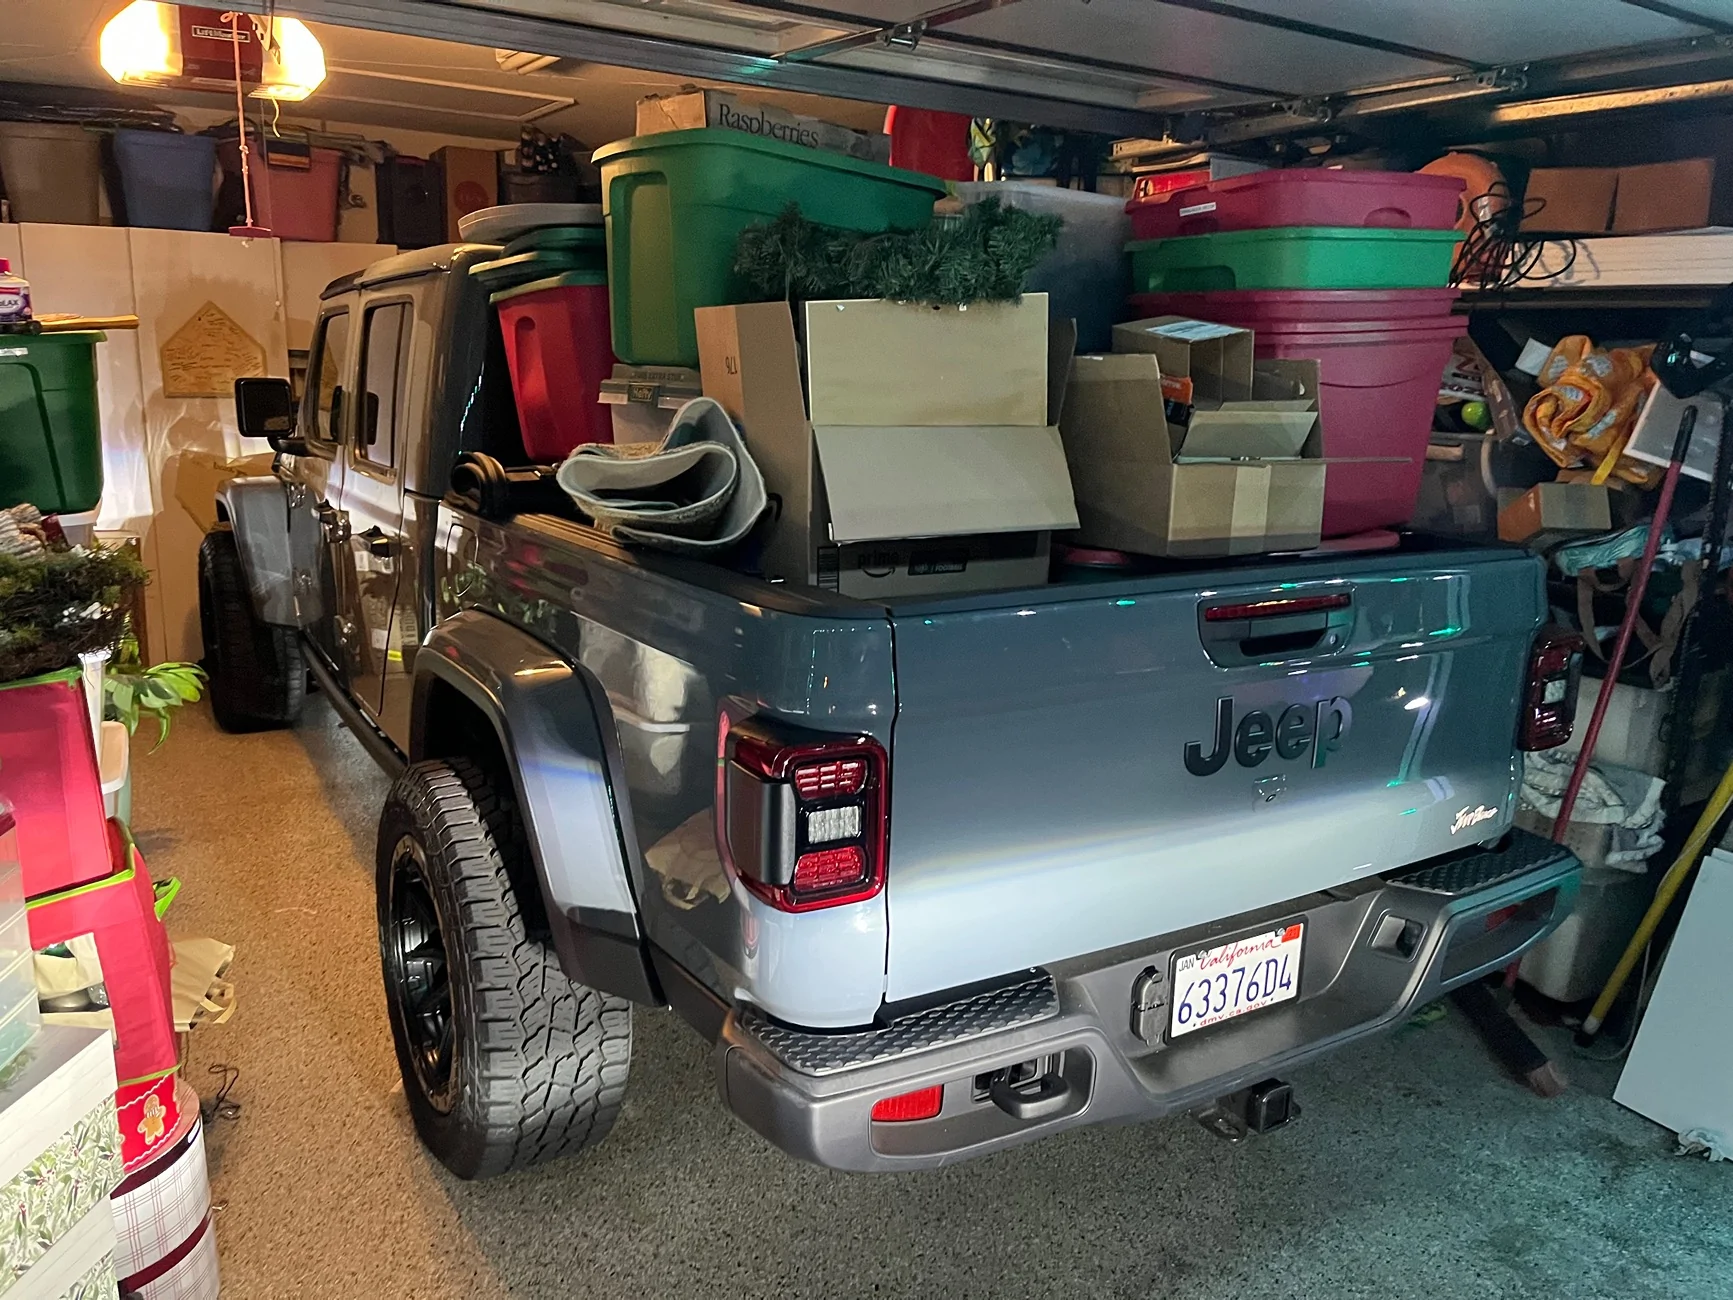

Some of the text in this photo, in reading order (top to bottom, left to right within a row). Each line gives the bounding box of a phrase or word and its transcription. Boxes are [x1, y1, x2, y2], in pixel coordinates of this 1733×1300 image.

[718, 103, 820, 149] Raspberries
[1184, 696, 1351, 777] Jeep
[1178, 957, 1195, 972] JAN
[1200, 937, 1282, 970] California
[1177, 954, 1293, 1025] 63376D4
[1199, 1000, 1268, 1027] dmv.ca.gov
